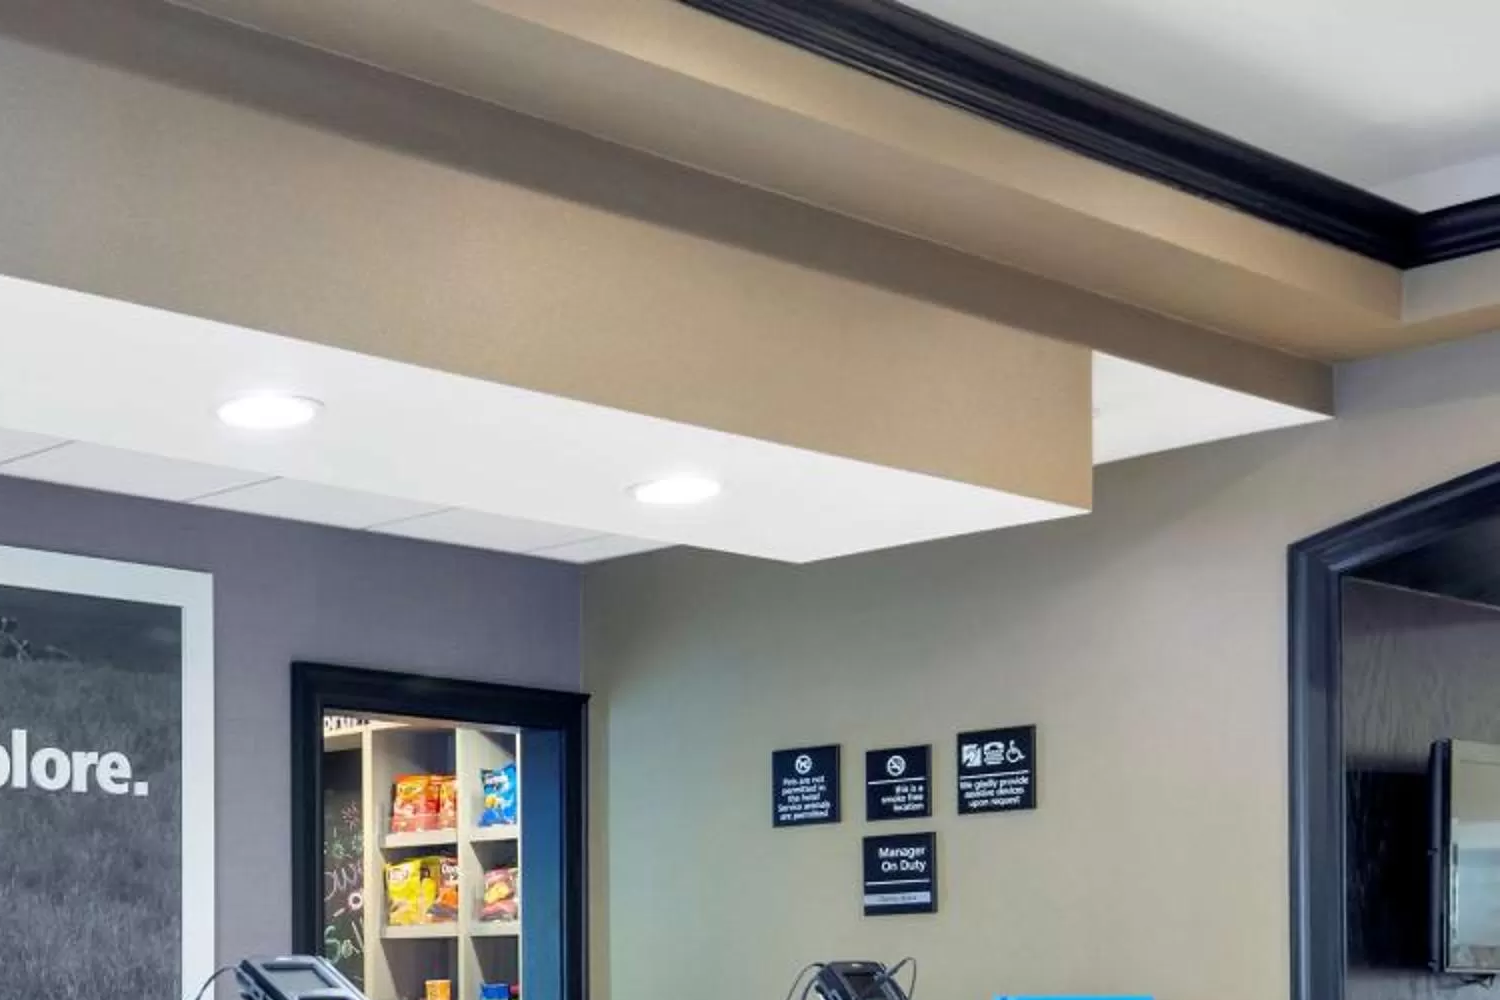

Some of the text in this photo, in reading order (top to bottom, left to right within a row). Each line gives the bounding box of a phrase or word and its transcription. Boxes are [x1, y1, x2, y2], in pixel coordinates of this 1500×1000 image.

[879, 847, 925, 859] Manager
[881, 859, 926, 872] On Duty
